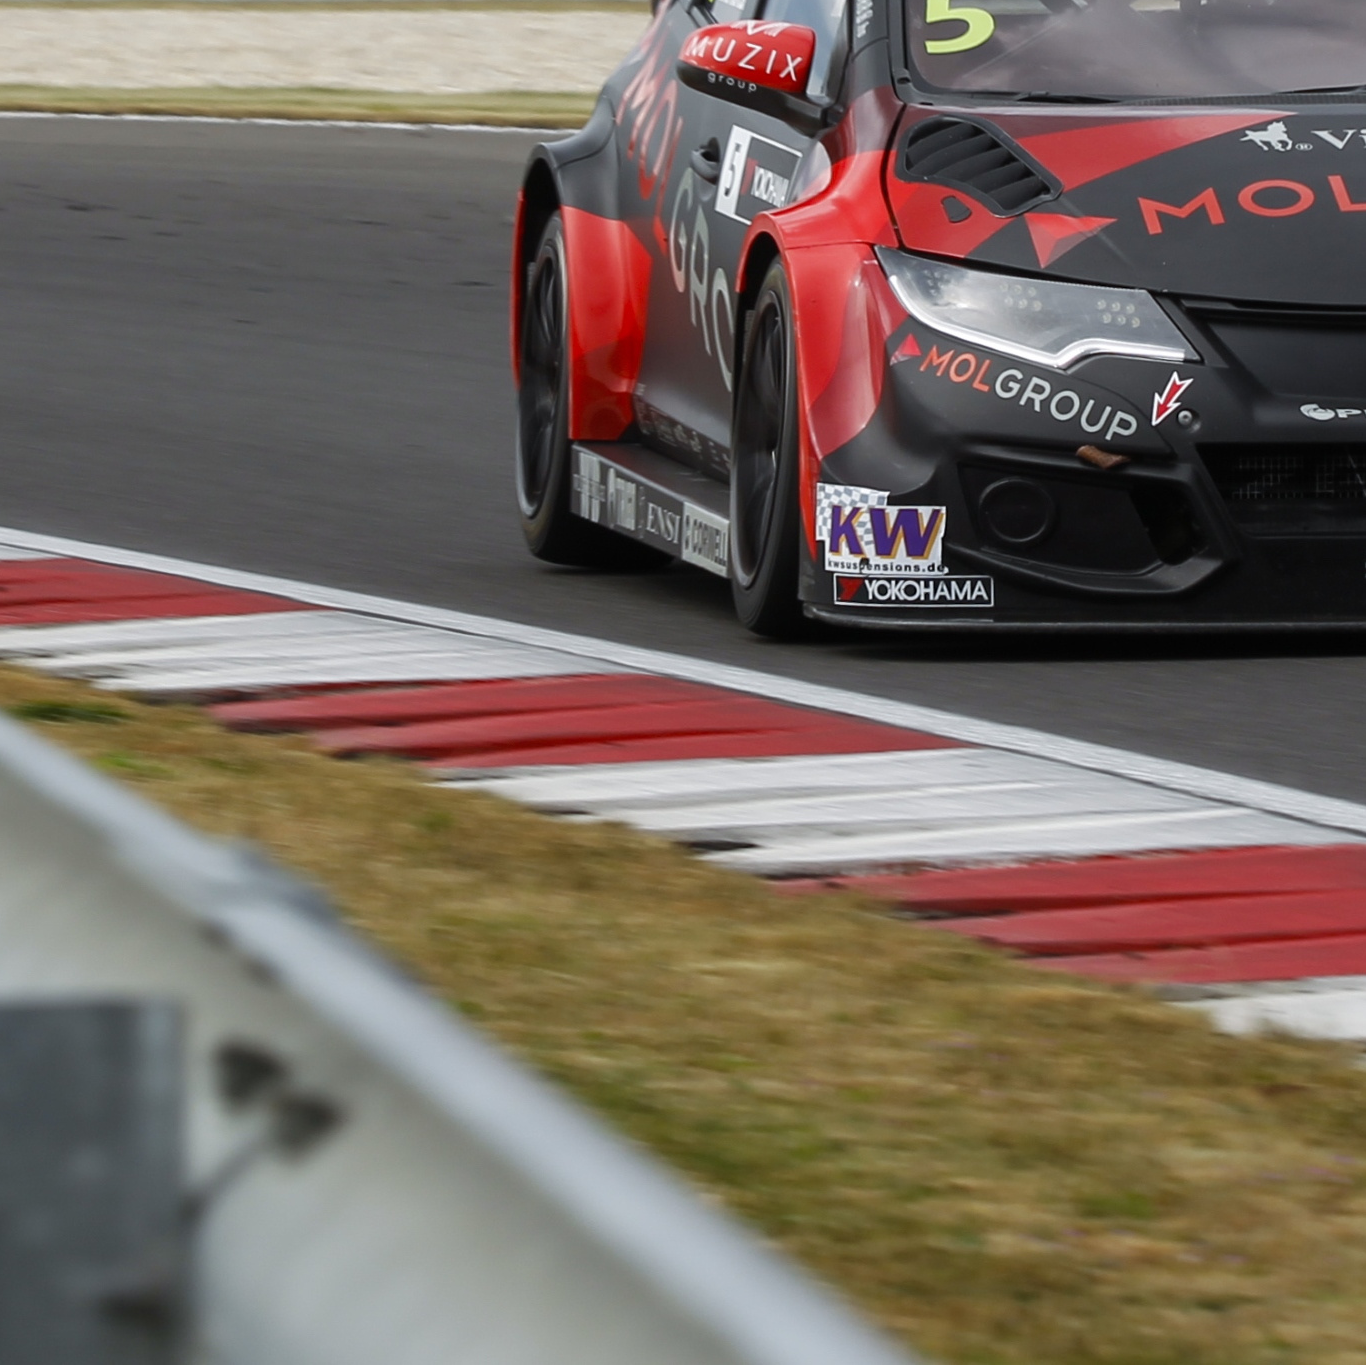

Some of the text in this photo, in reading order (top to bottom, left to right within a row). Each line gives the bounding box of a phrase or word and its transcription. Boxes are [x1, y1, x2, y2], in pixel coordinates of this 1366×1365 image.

[685, 35, 803, 82] MUZIX
[707, 72, 757, 93] group
[829, 504, 945, 560] KW
[864, 579, 989, 601] YOKOHAMA
